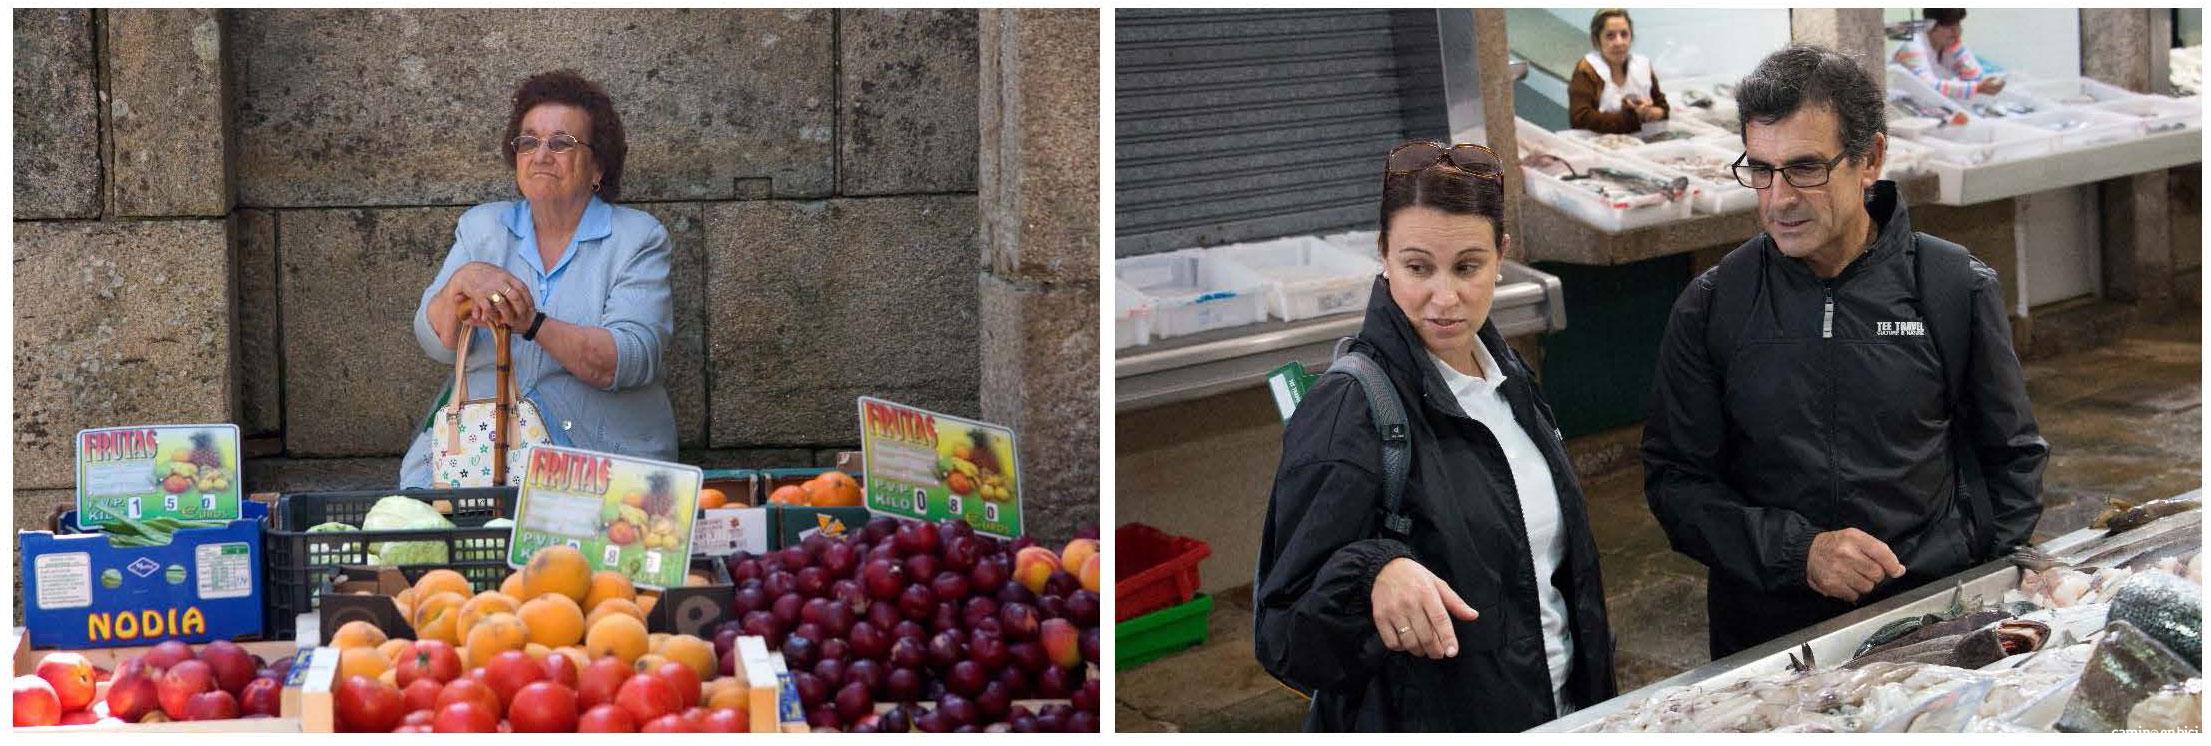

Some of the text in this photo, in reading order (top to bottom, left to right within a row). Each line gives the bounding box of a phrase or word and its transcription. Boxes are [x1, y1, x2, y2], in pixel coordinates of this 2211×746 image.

[1876, 322, 1924, 331] TEE TRAVEL
[864, 401, 939, 448] FRUTAS
[84, 430, 158, 462] FRUTAS
[530, 448, 612, 495] FRUTAS
[88, 606, 206, 641] NODIA
